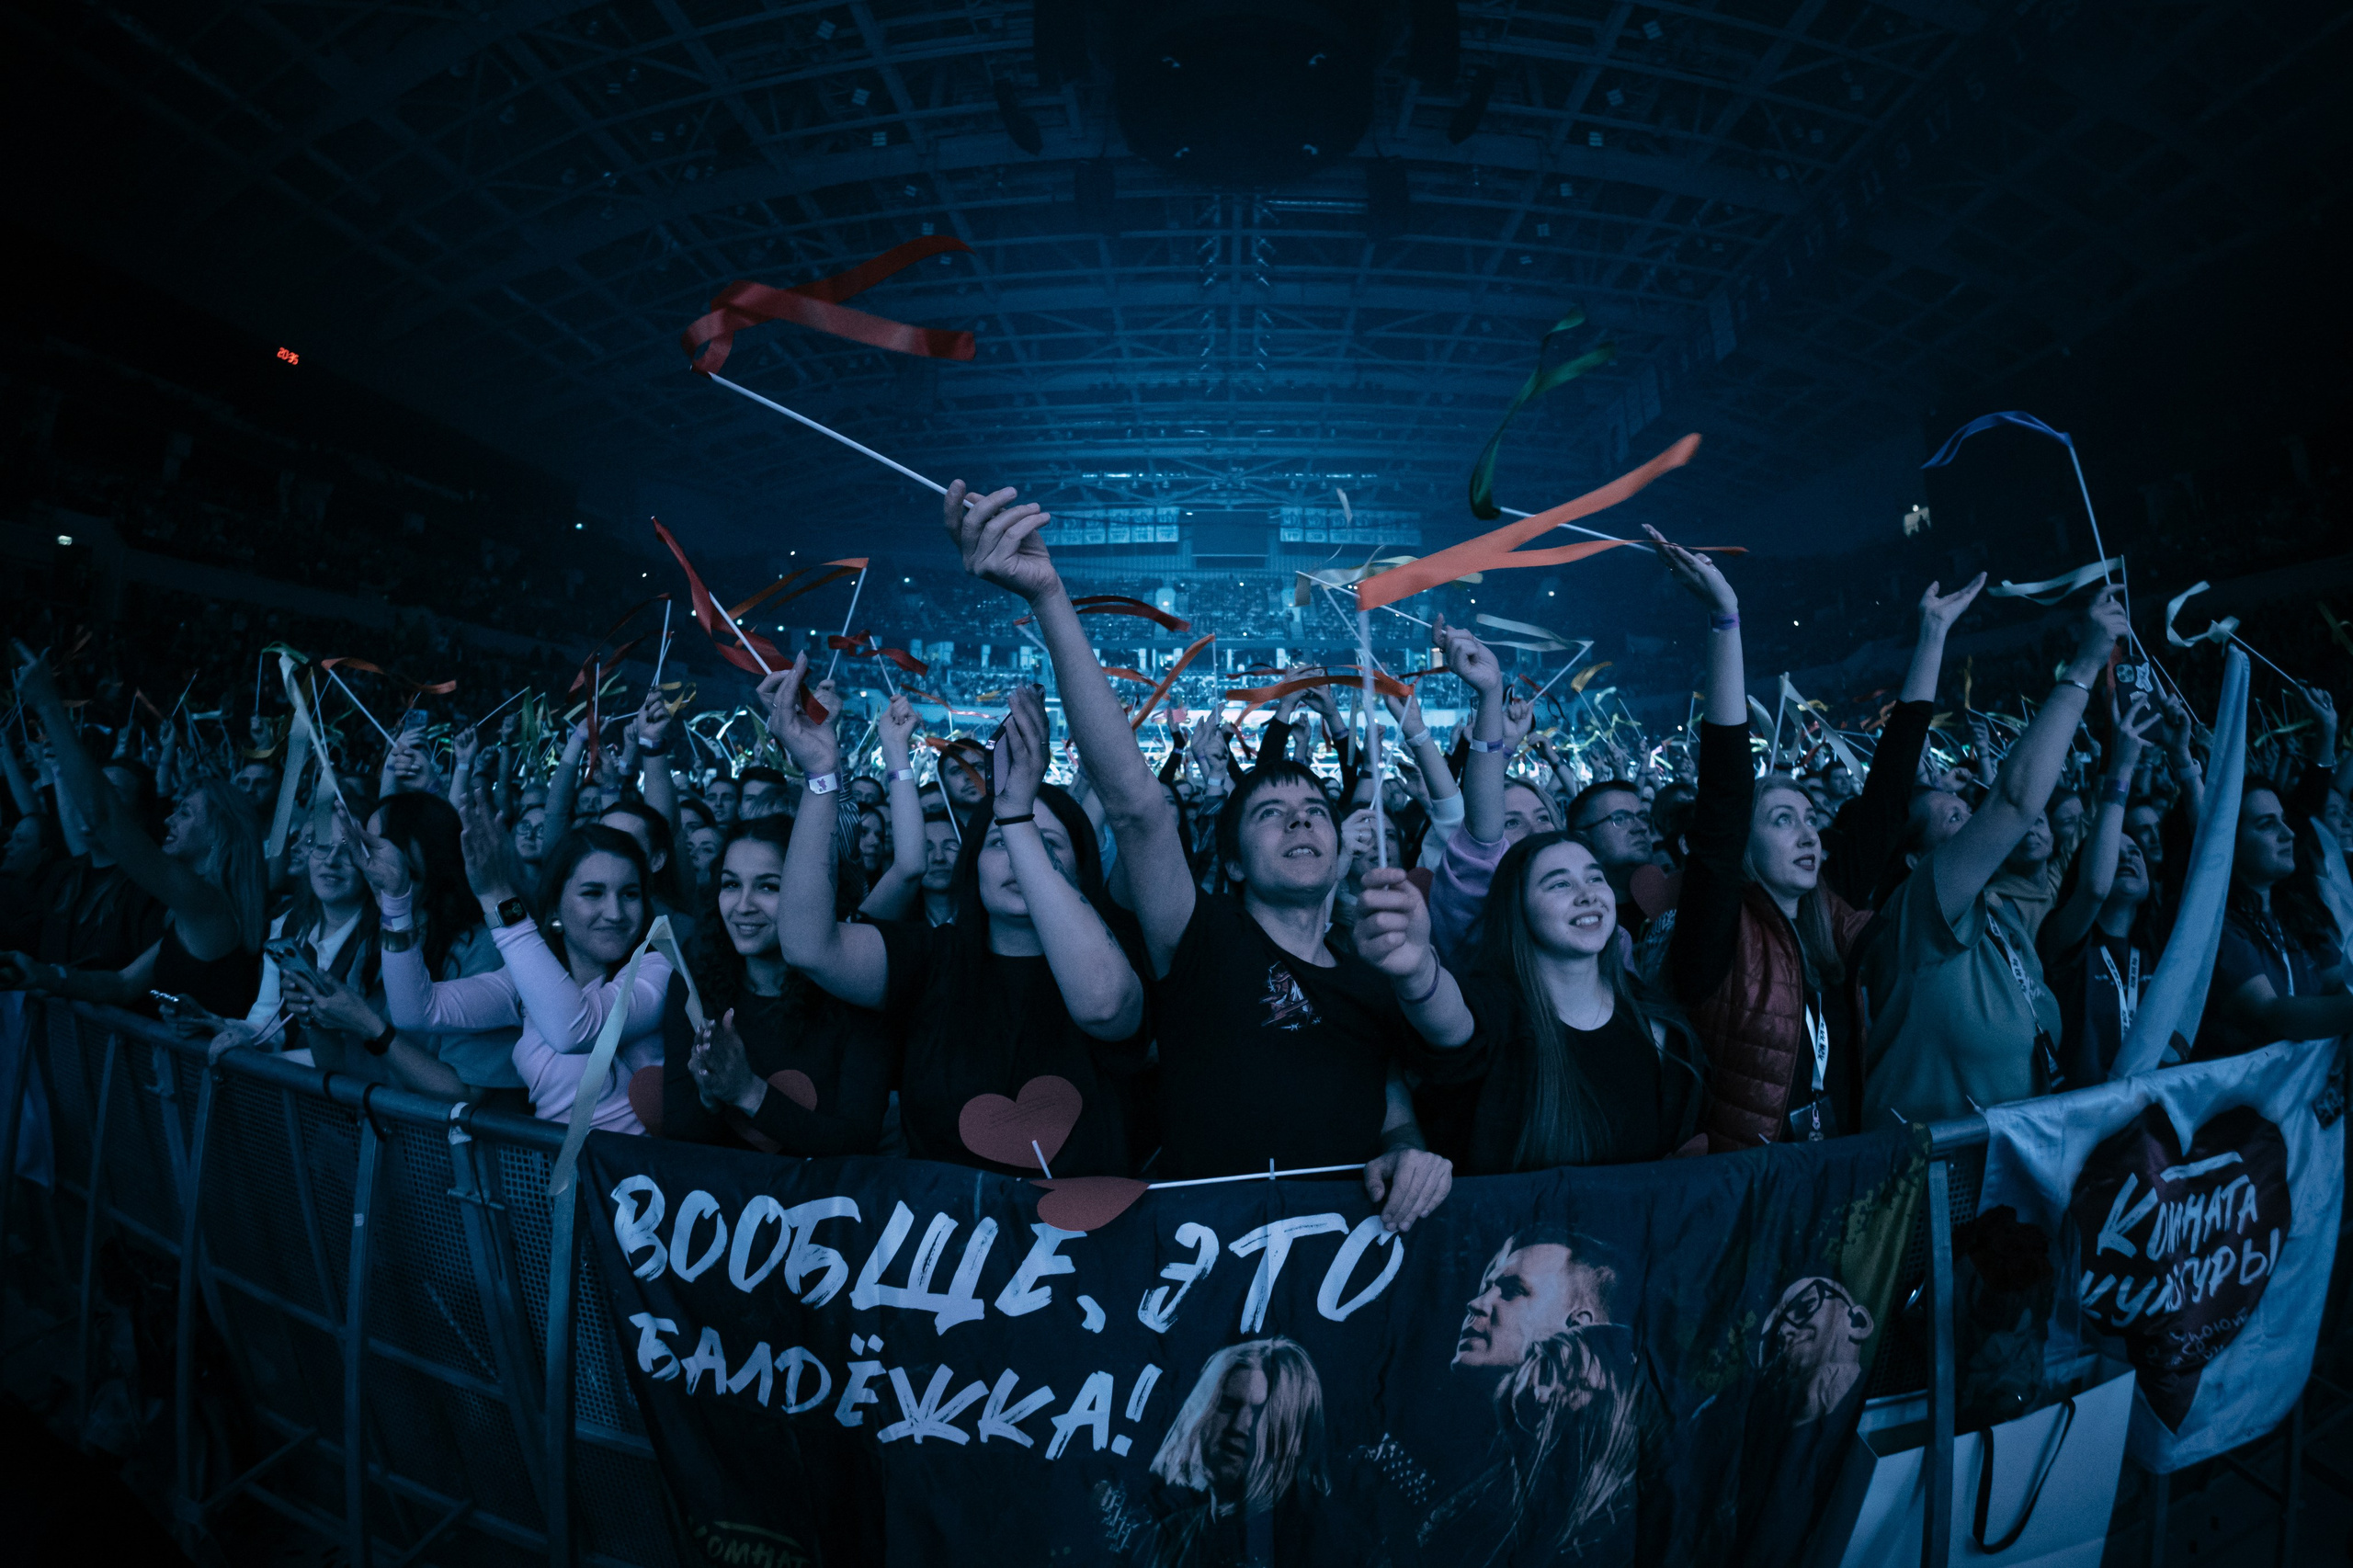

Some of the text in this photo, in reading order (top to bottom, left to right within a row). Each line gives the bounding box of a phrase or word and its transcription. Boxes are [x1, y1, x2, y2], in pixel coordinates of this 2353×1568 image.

[610, 1175, 1404, 1335] ВООБЩЕ, ЭТО
[2081, 1228, 2280, 1327] КУЛЬТУРЫ
[2097, 1173, 2257, 1261] КОМНАТА
[629, 1312, 1163, 1460] БАЛДЁЖКА!
